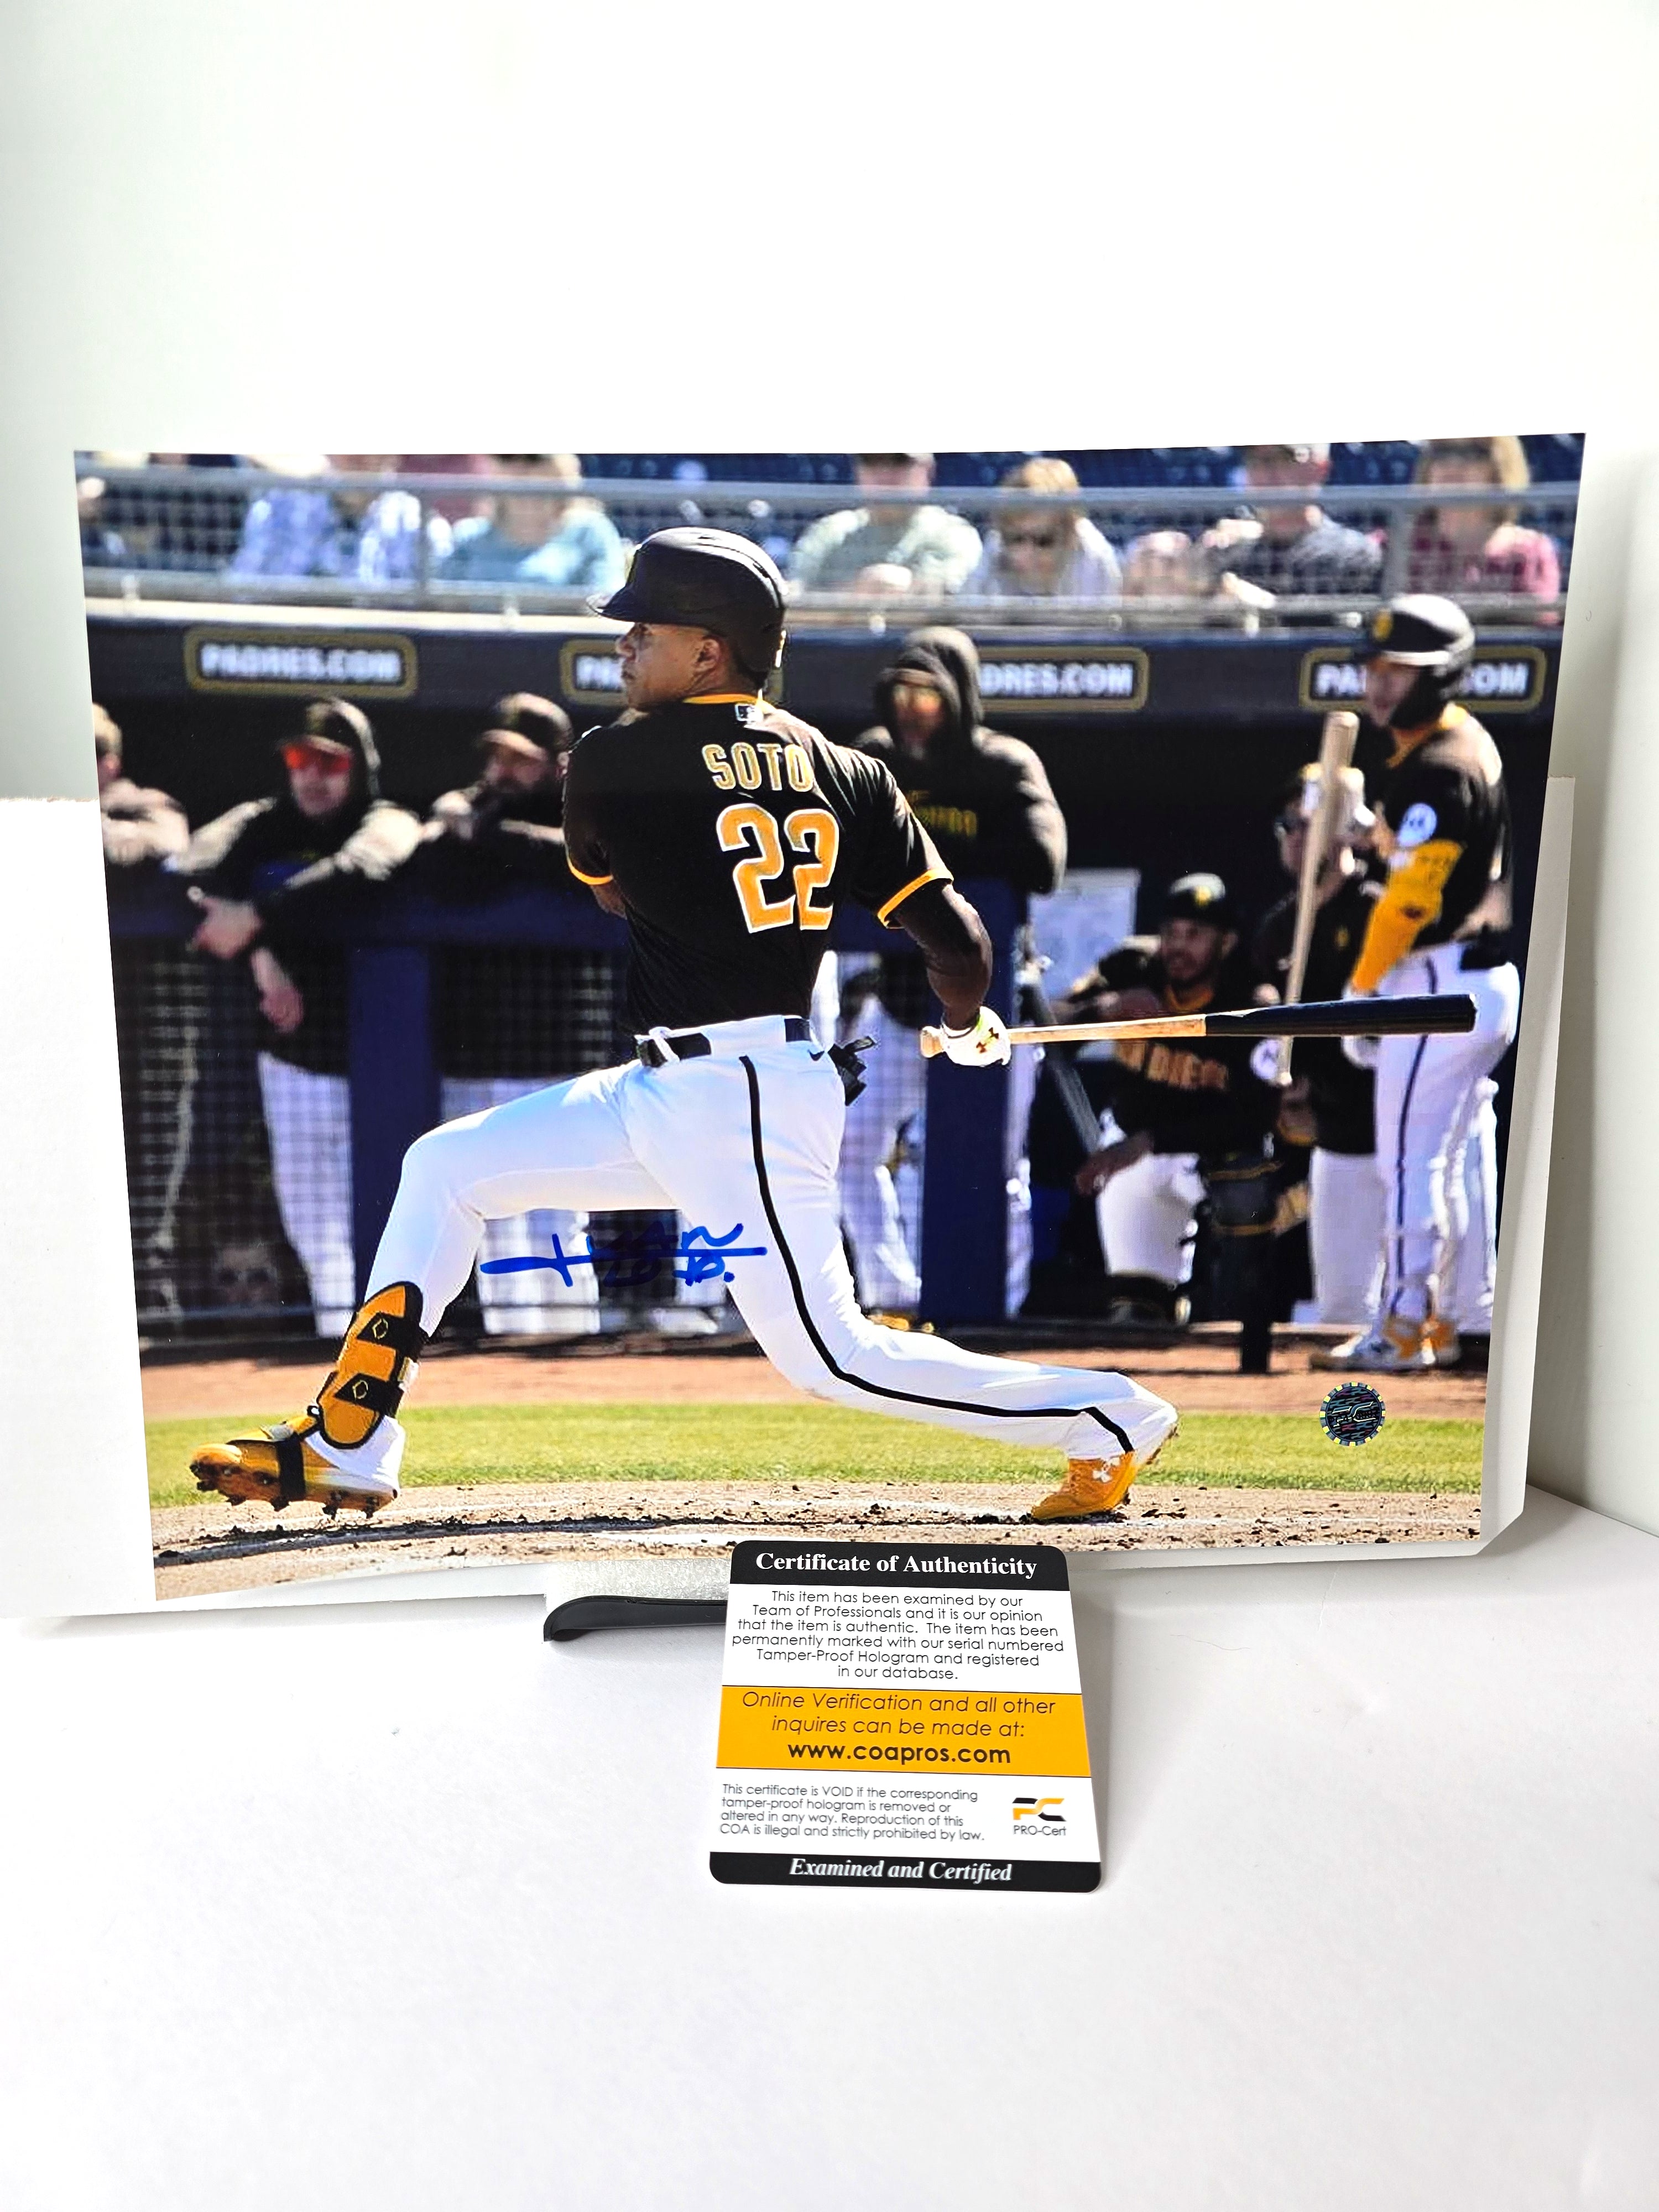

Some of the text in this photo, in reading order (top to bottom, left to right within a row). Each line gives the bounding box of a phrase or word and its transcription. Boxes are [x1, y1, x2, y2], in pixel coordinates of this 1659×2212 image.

[980, 663, 1133, 697] DRES.COM
[702, 742, 814, 792] SOTO
[716, 803, 839, 934] 22
[756, 1553, 1037, 1579] Certificate of Authenticity
[771, 1590, 1023, 1609] This item has been examined by our
[752, 1604, 1042, 1623] Team of Professionals and it is our opinion
[738, 1619, 1058, 1636] that the item is authentic. The item has been
[732, 1635, 1064, 1652] permanently marked with our serial numbered
[757, 1648, 1039, 1668] Tamper-Proof Hologram and registered
[838, 1664, 958, 1679] in our database.
[743, 1691, 1056, 1714] Online Verification and all other
[772, 1715, 1024, 1737] inquires can be made at:
[787, 1744, 1011, 1765] www.coapros.com
[723, 1783, 978, 1803] This certificate is VOID if the corresponding
[722, 1797, 951, 1813] tamper-proof hologram is removed or
[721, 1810, 963, 1827] altered in any way. Reproduction of this
[720, 1823, 985, 1842] COA is illegal and strictly prohibited by law.
[1013, 1825, 1067, 1836] PRO-Cert
[789, 1858, 1012, 1884] Examined and Certified
